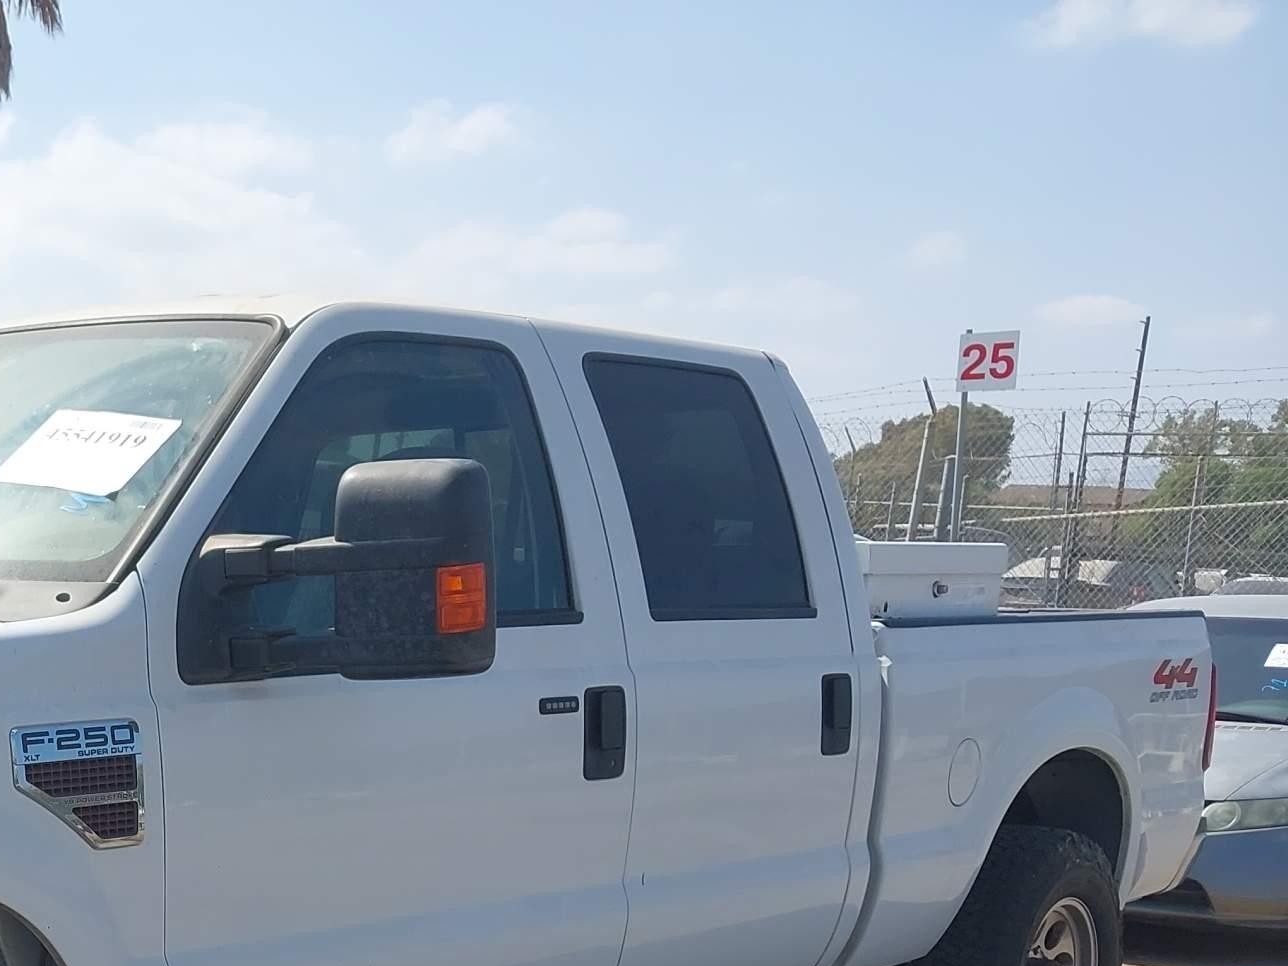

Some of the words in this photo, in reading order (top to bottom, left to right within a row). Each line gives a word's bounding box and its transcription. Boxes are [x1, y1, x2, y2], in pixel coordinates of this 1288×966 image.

[960, 342, 1015, 380] 25
[21, 724, 135, 754] F-250
[23, 754, 41, 763] XLT
[77, 747, 109, 757] SUPER
[110, 745, 136, 754] DUTY
